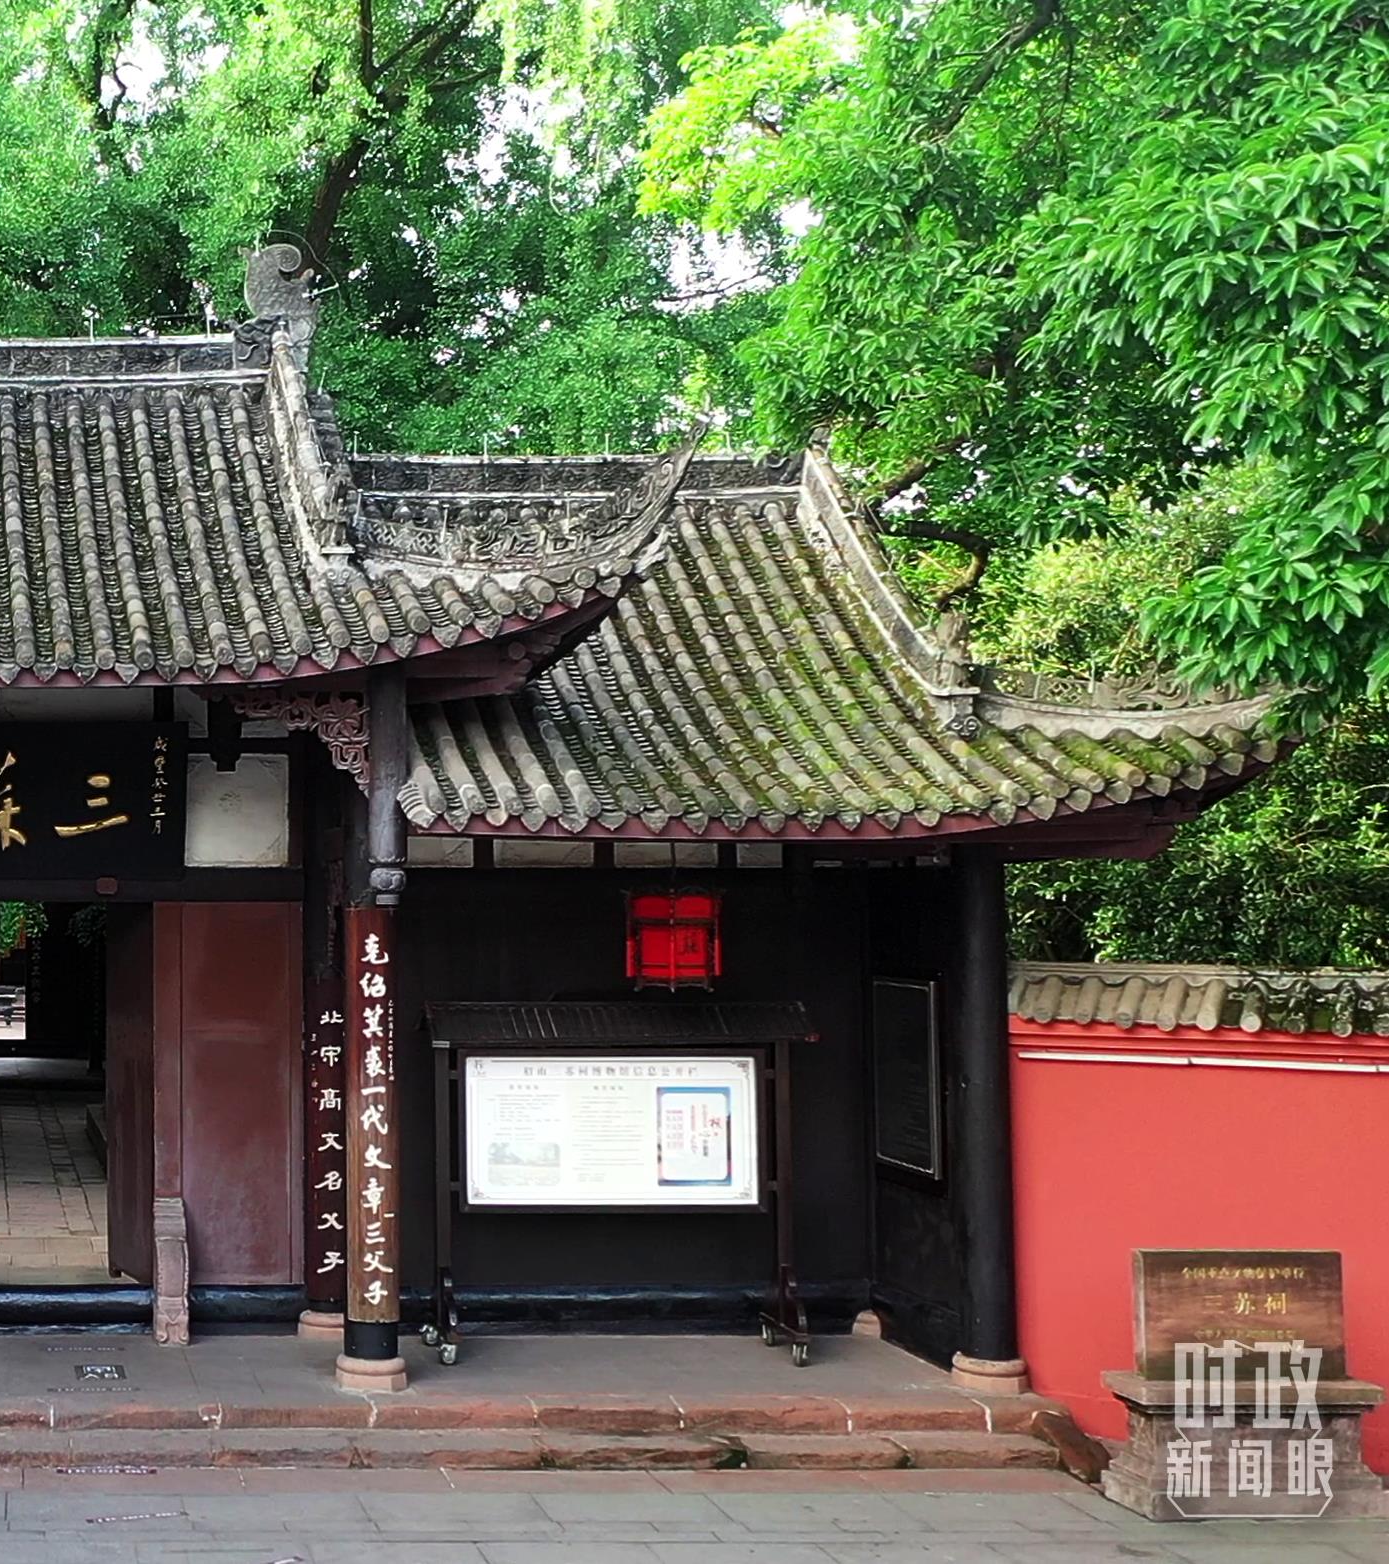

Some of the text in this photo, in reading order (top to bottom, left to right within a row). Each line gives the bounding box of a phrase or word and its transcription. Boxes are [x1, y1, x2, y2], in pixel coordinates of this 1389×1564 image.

[314, 1010, 345, 1274] 北宋高文名父子
[1202, 1292, 1288, 1315] 三苏祠
